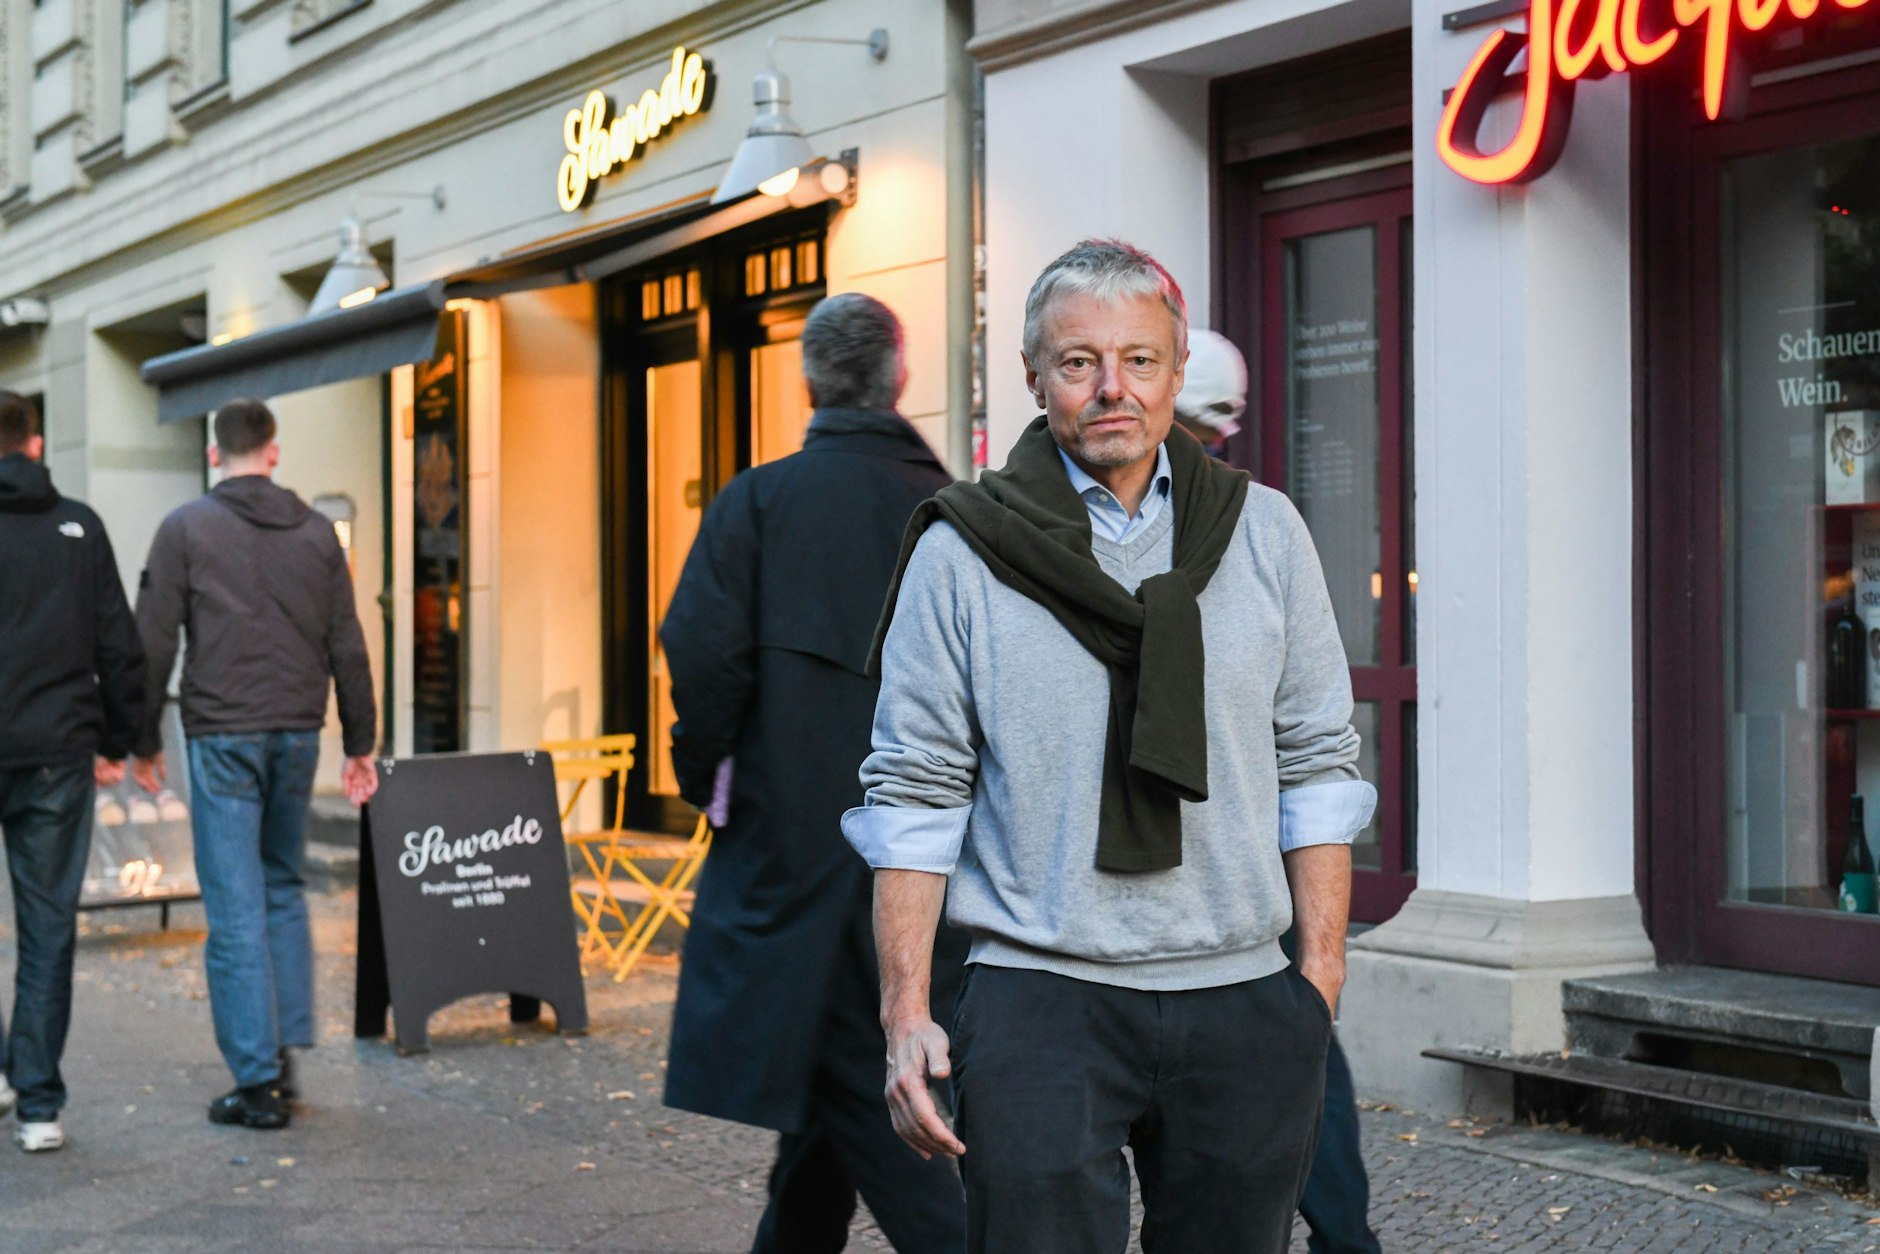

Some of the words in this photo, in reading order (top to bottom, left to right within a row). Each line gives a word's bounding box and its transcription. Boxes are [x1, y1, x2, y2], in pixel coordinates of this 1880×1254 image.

[558, 46, 706, 212] Sawade
[1777, 372, 1848, 408] Wein.
[398, 814, 543, 877] Sawade
